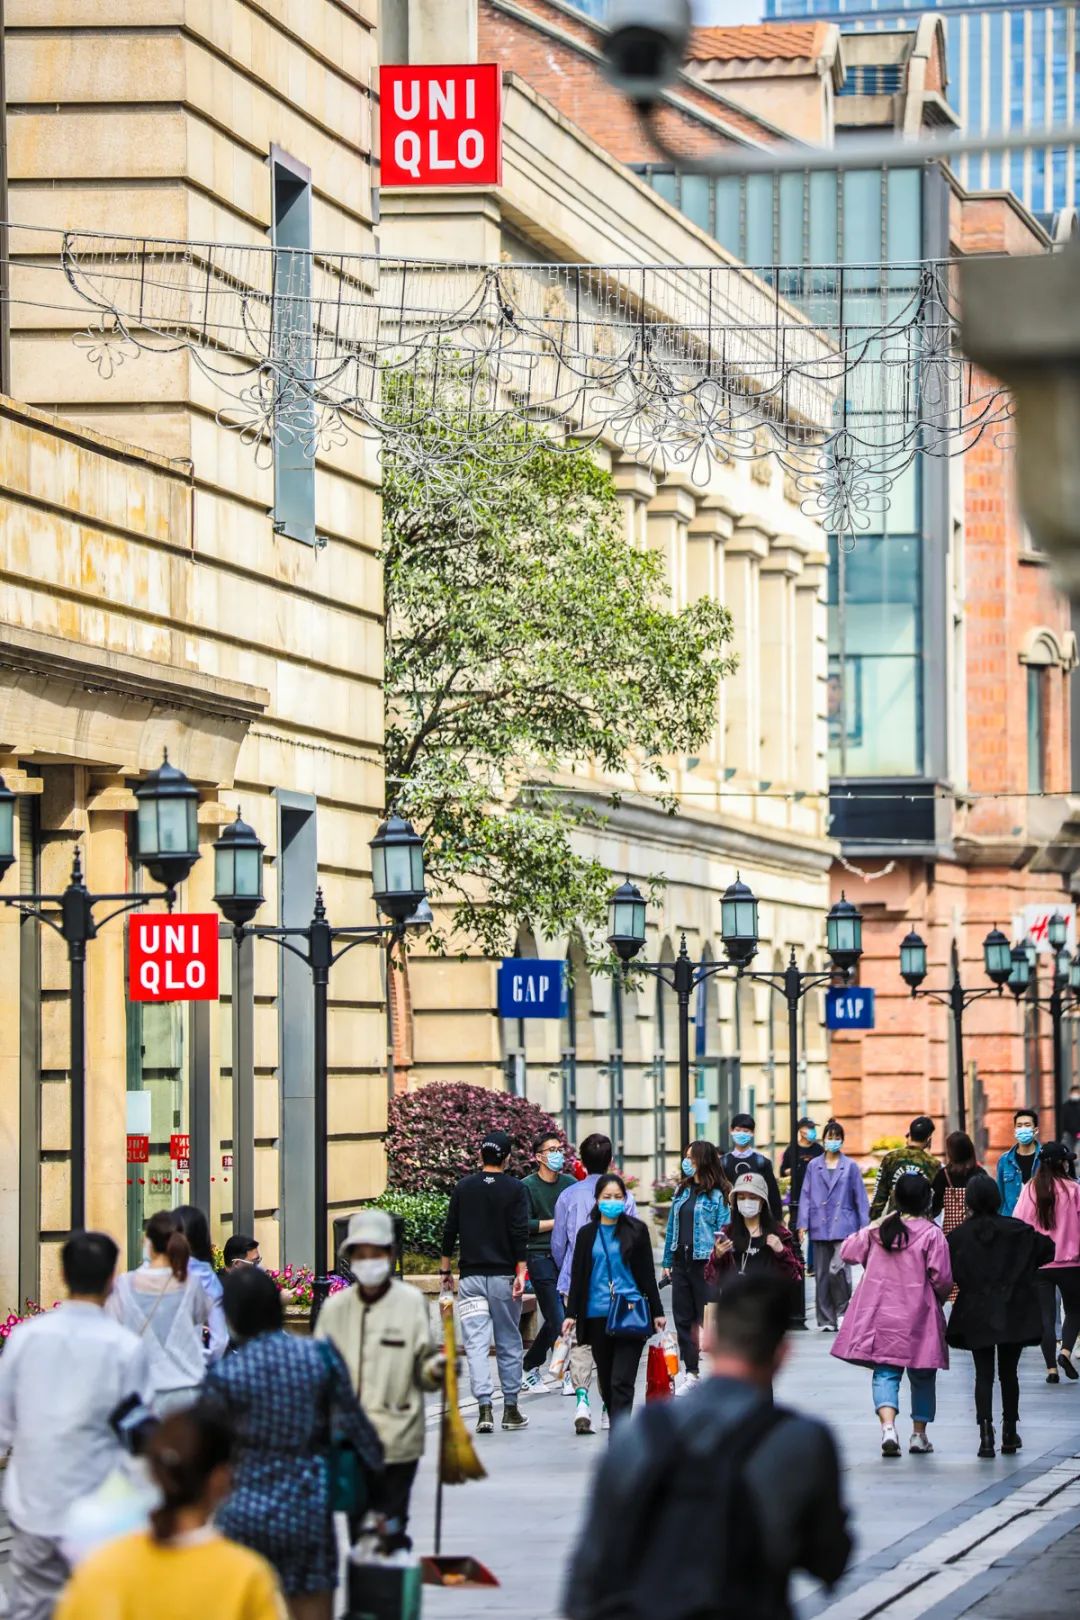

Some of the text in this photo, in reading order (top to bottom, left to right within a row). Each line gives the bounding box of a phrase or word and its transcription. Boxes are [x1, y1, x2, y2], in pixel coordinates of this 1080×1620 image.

[393, 79, 476, 121] UNI
[394, 128, 485, 178] QLO
[139, 924, 199, 954] UNI
[140, 960, 206, 994] QLO
[512, 975, 549, 1003] GAP
[835, 997, 864, 1019] GAP
